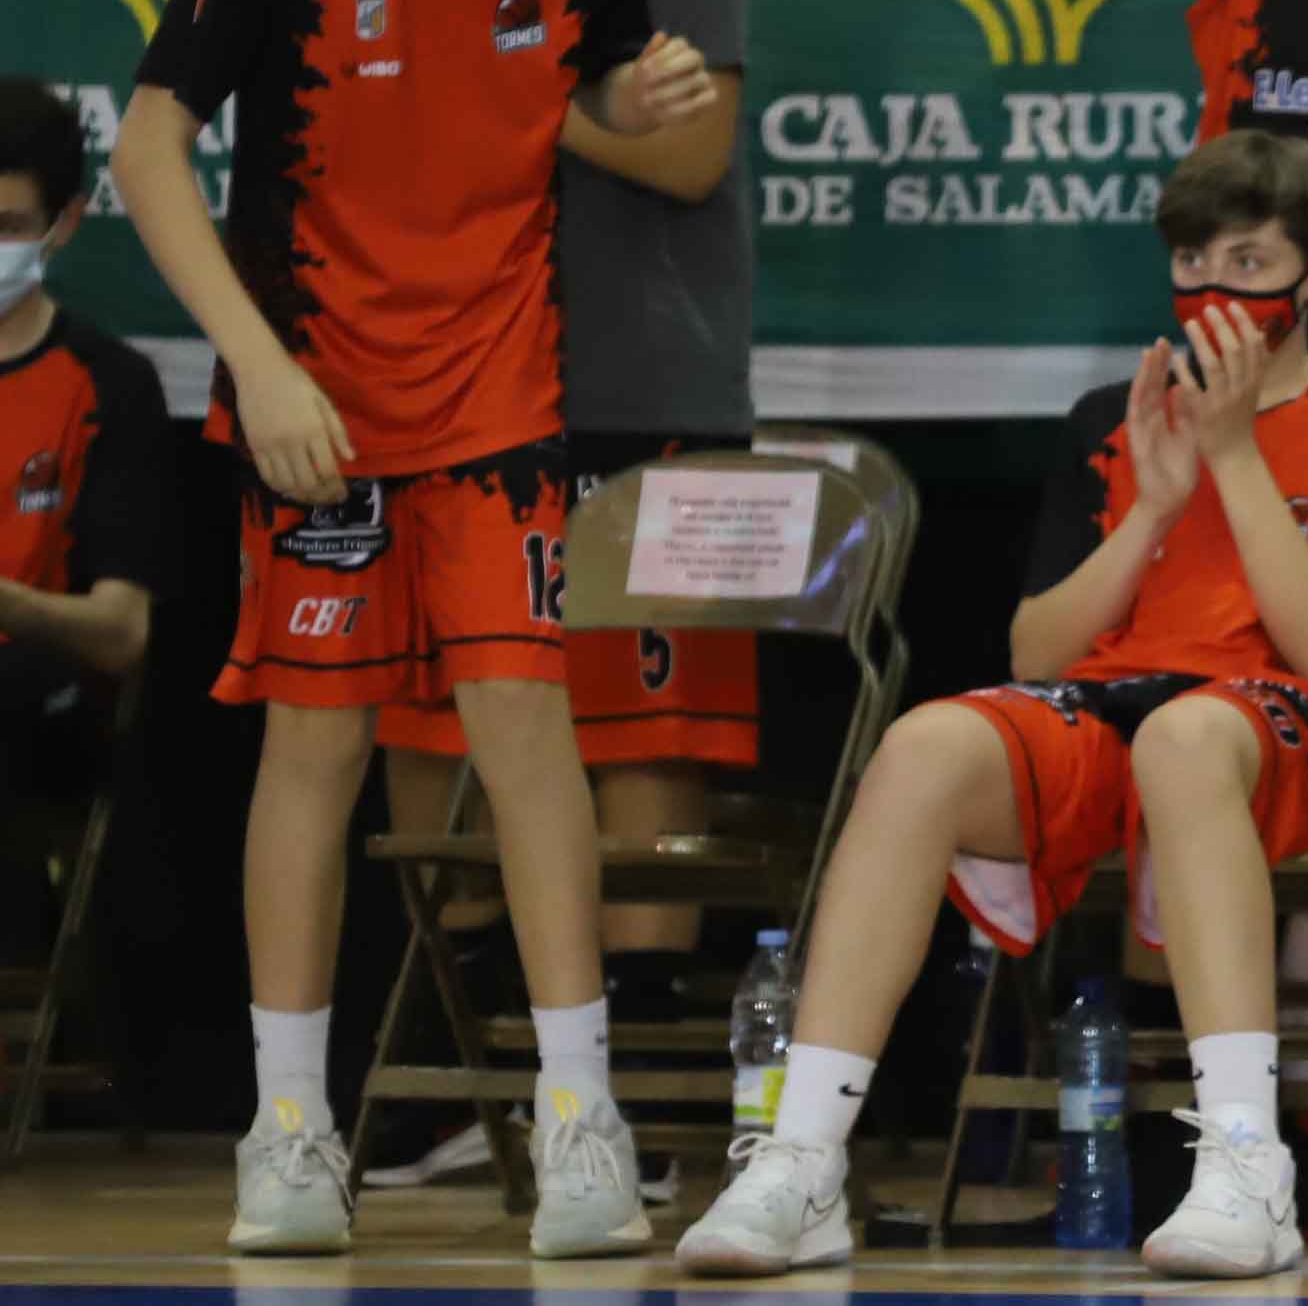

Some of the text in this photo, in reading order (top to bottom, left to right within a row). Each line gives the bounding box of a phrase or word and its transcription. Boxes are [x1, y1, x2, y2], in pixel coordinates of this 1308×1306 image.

[760, 93, 1207, 164] CAJA RUR
[760, 174, 1166, 225] DE SALAMA
[287, 596, 368, 637] CBT
